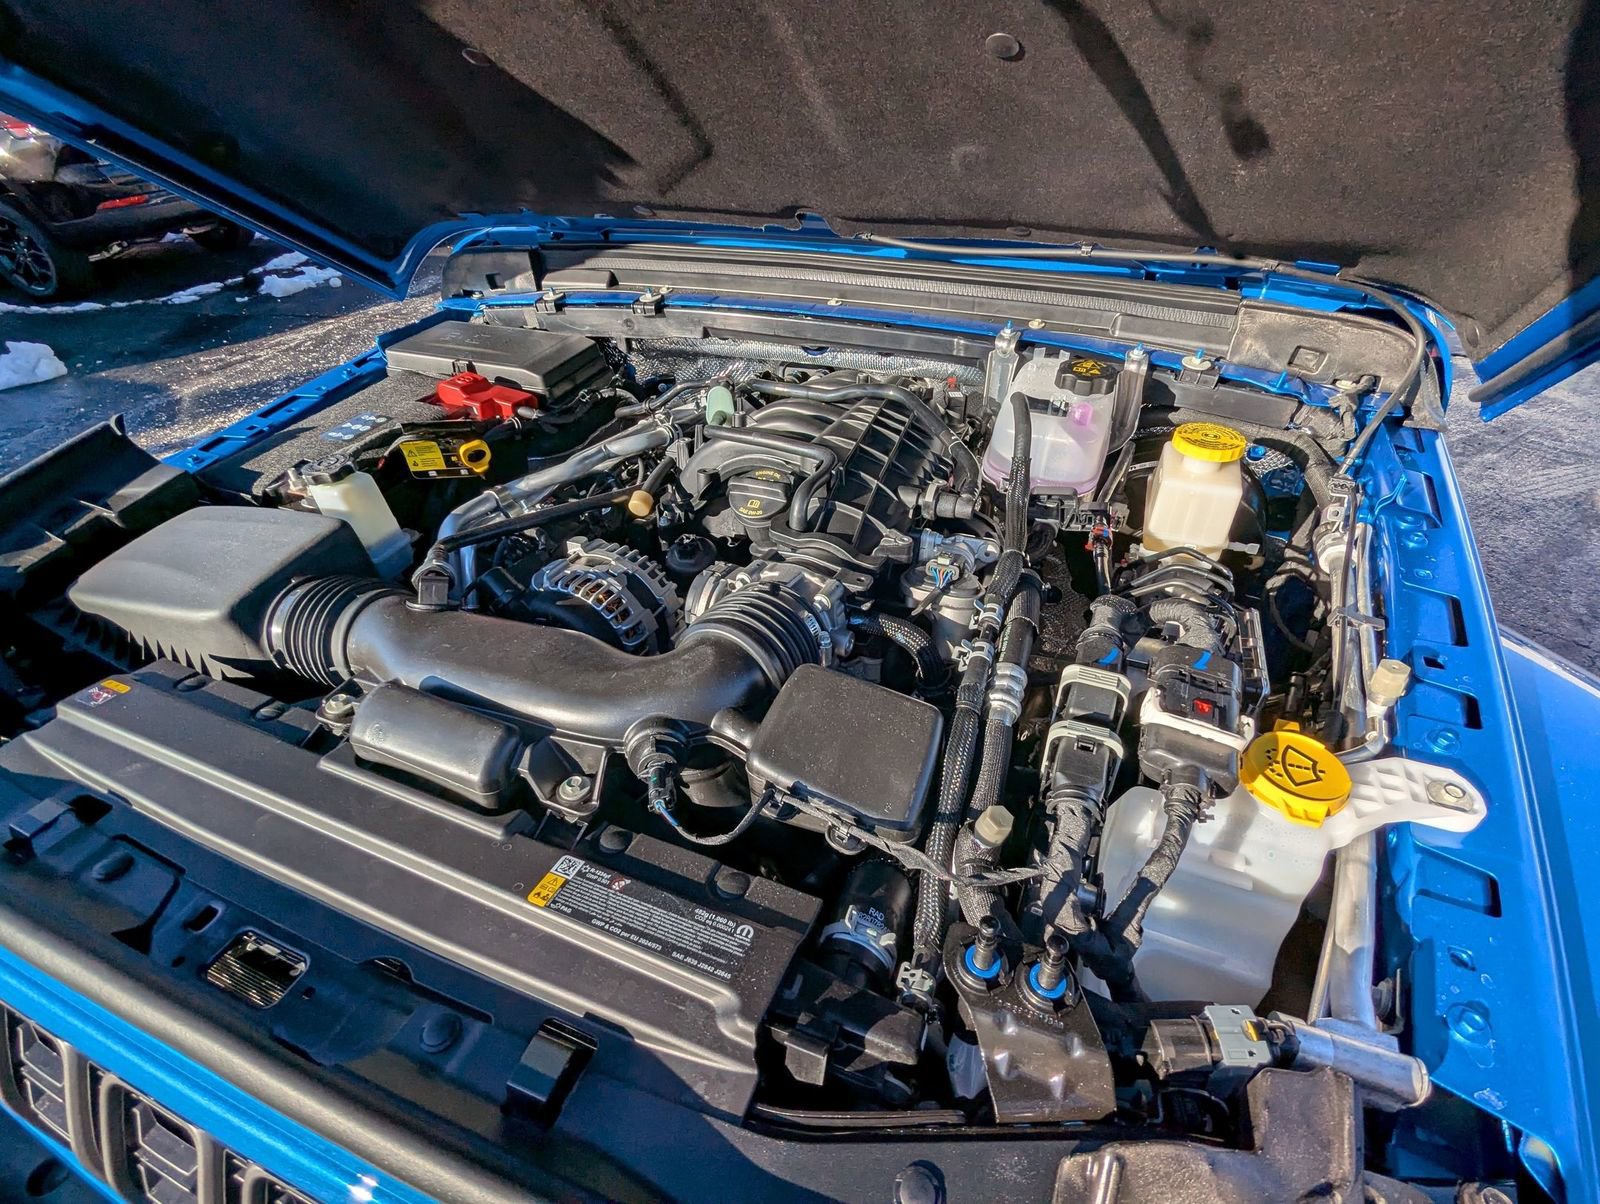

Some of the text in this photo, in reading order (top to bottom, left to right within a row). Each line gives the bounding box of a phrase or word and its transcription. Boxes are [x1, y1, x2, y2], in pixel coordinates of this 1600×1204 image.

[560, 904, 573, 914] PAG
[868, 906, 885, 921] RAD
[694, 914, 705, 922] CO2
[694, 908, 710, 918] 482g
[727, 920, 737, 929] lb)
[609, 925, 622, 934] CO2
[630, 933, 640, 941] EU
[671, 951, 685, 961] SAE
